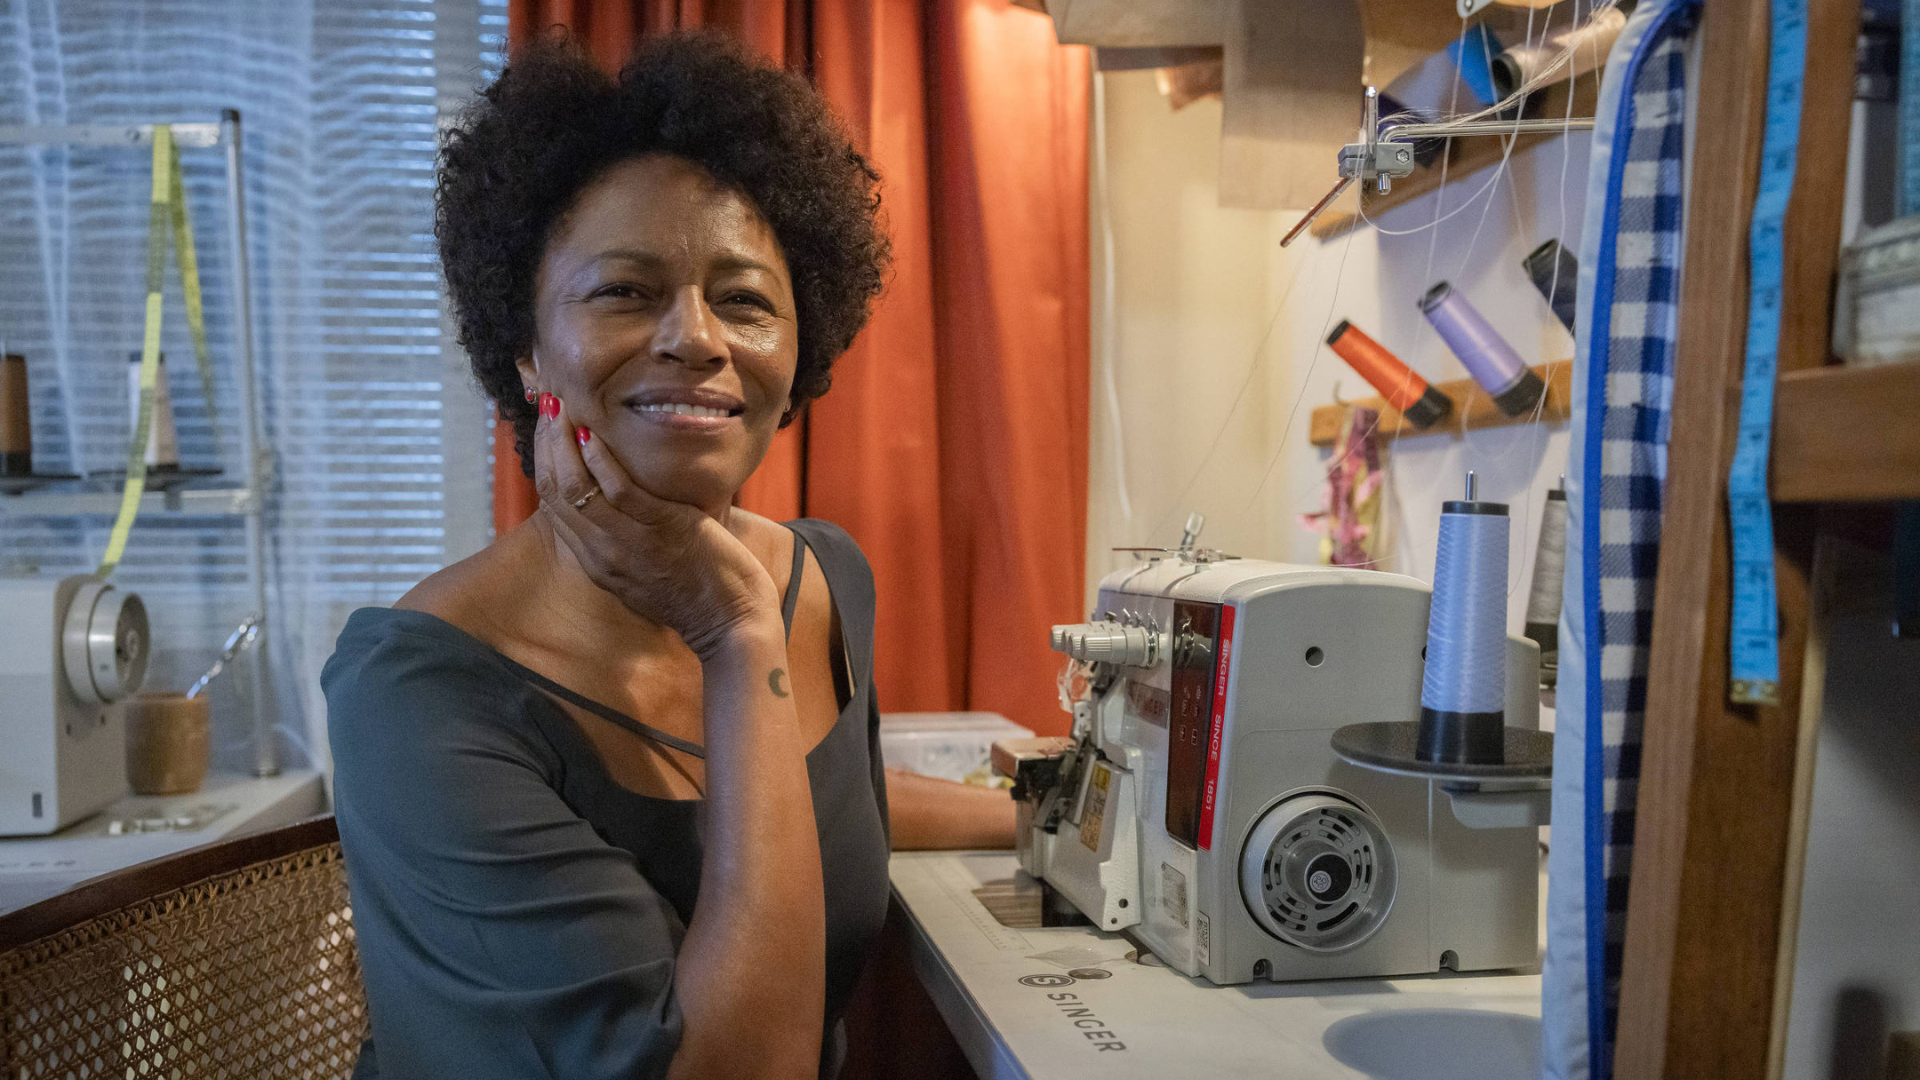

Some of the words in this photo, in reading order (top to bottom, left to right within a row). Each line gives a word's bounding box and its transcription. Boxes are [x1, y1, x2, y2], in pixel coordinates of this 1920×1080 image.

[1218, 639, 1230, 696] SINGER
[1211, 714, 1221, 760] SINCE
[1205, 780, 1215, 810] 1851
[1047, 992, 1127, 1052] SINGER
